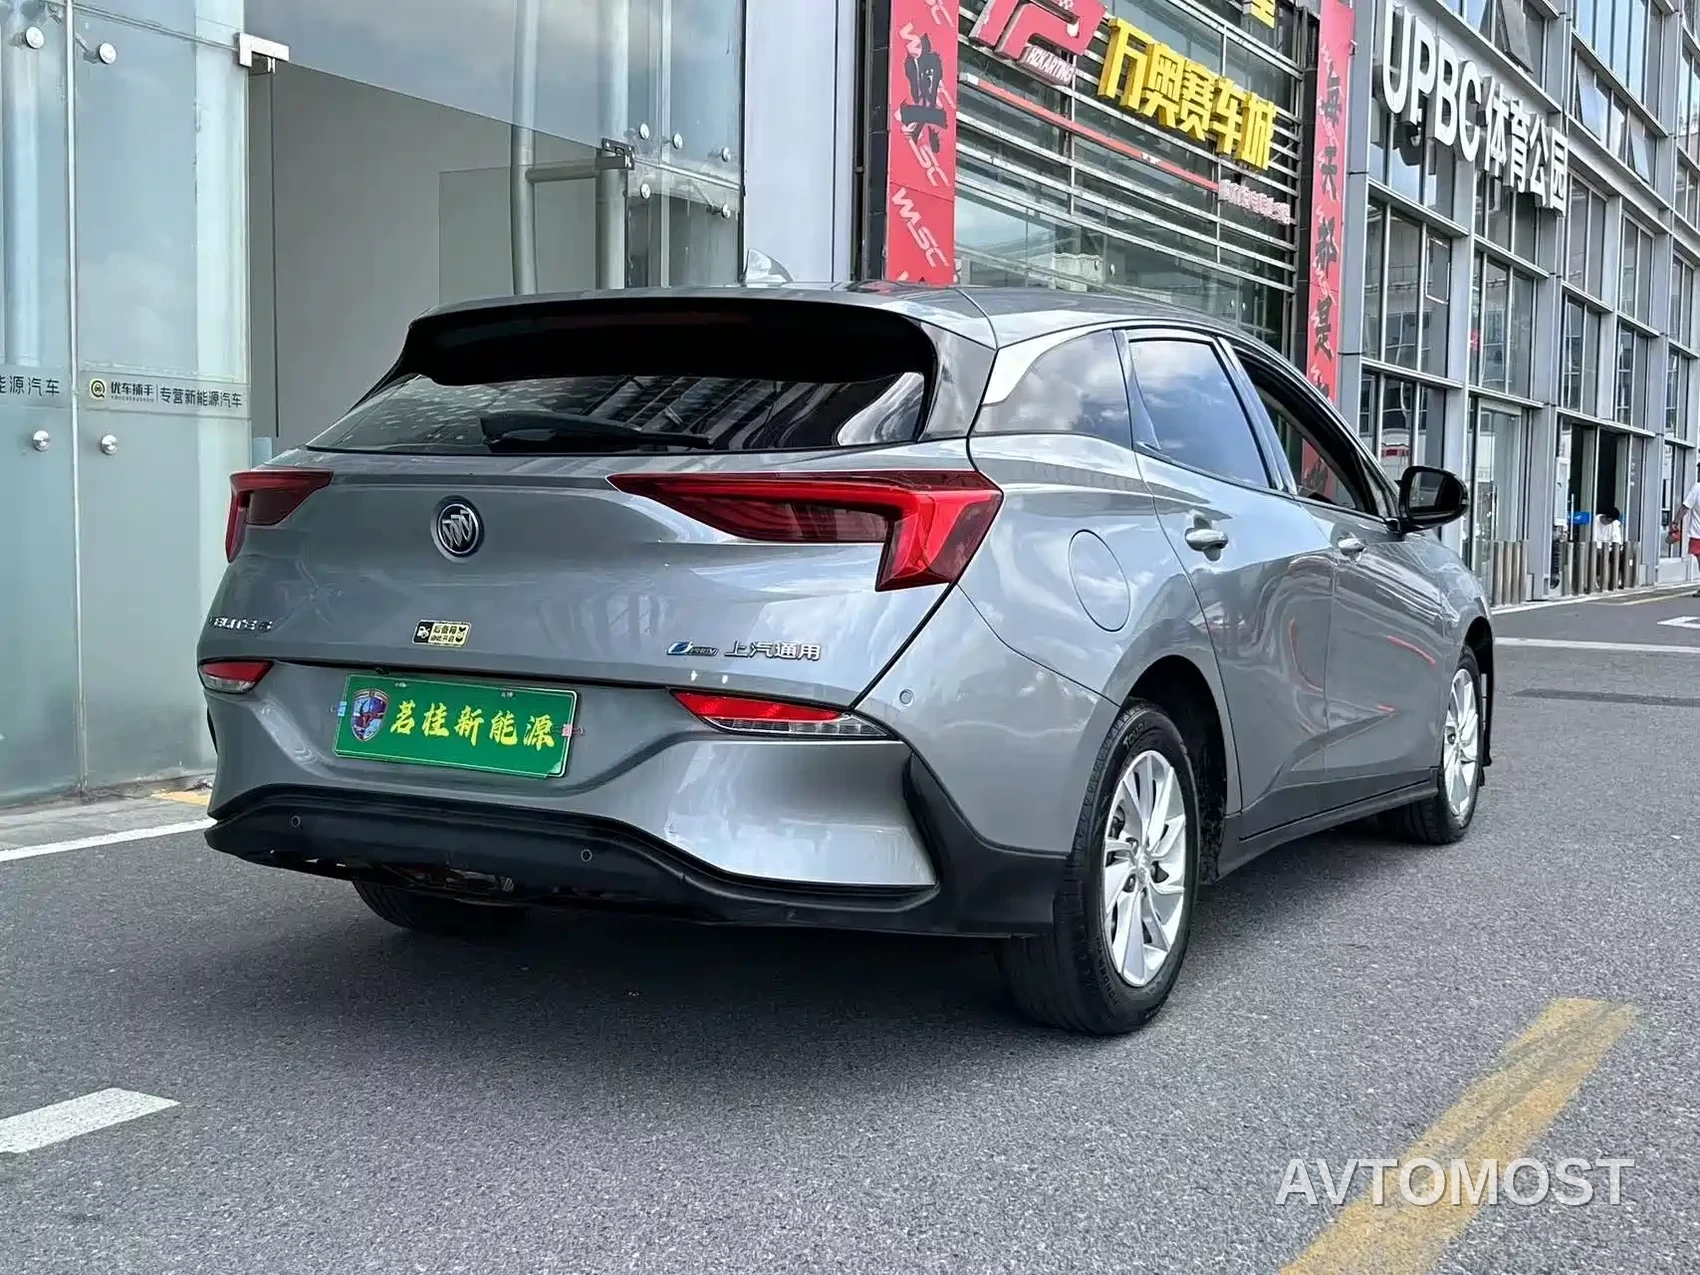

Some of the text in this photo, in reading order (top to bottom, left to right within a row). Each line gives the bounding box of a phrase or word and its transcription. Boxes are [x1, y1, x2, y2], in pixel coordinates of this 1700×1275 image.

[1098, 18, 1276, 171] 万奥赛车城
[111, 381, 154, 396] 优车捕手
[160, 387, 242, 408] 专营新能源汽车
[724, 640, 822, 661] 上汽通用
